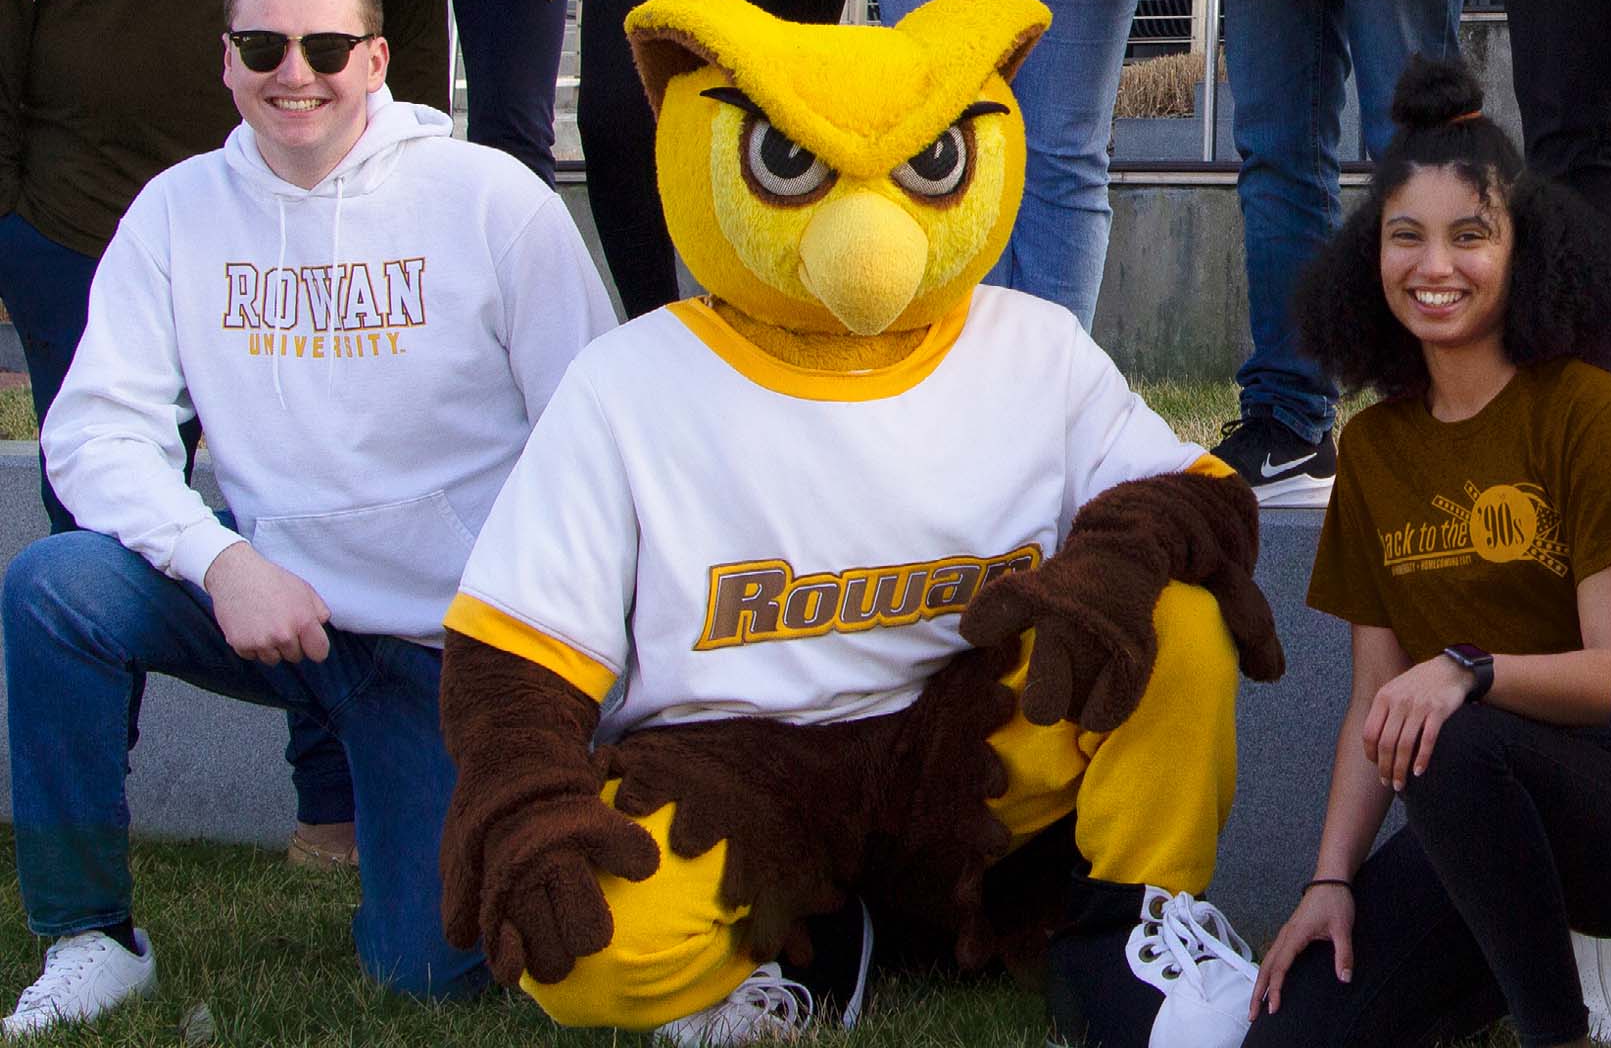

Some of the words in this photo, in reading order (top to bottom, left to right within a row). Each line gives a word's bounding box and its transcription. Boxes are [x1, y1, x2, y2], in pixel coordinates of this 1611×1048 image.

[222, 256, 426, 333] ROWAN
[249, 331, 401, 359] UNIVERSITY
[1418, 522, 1437, 553] to
[1441, 517, 1468, 550] the
